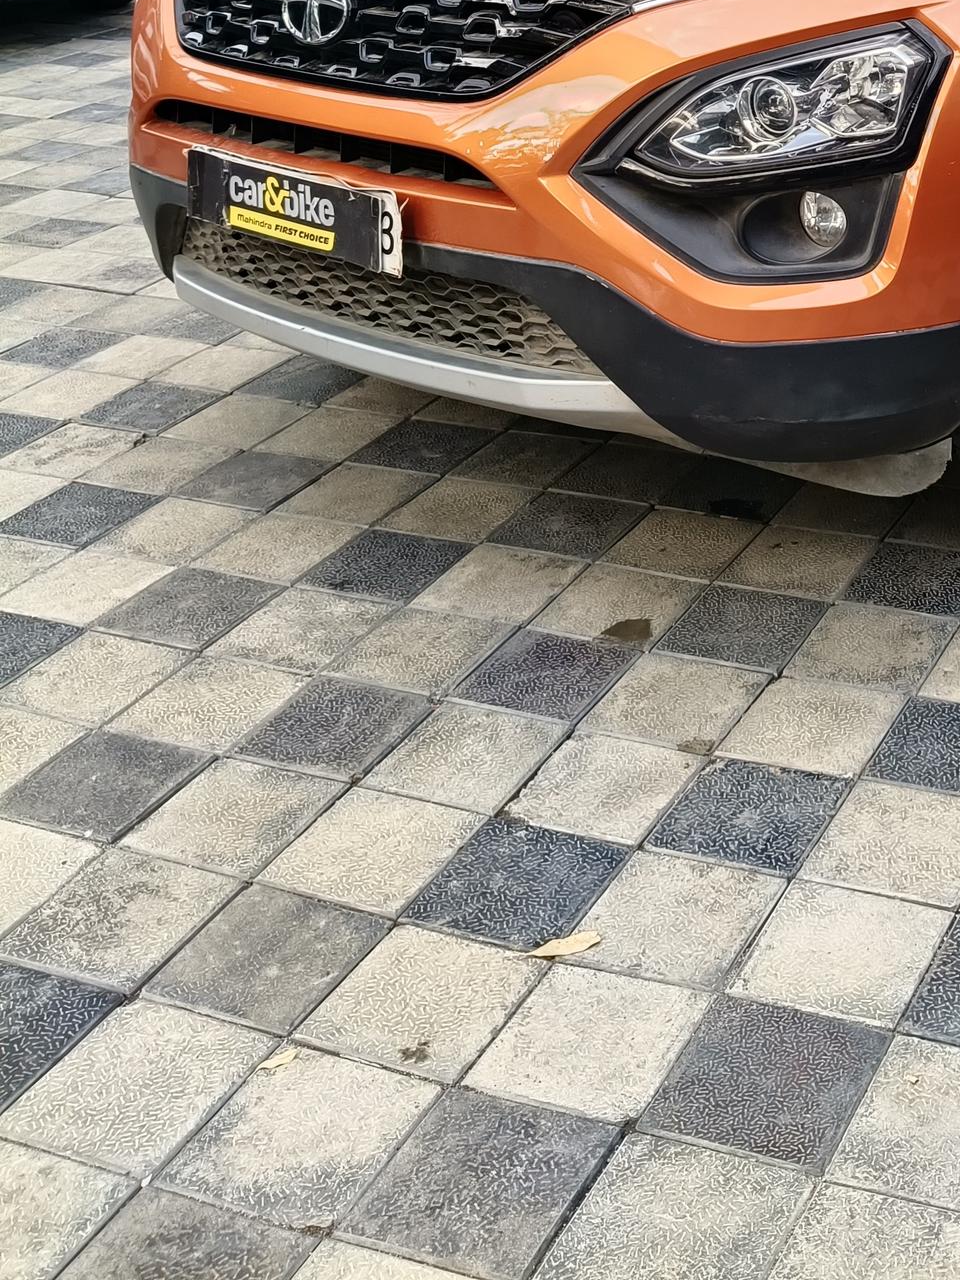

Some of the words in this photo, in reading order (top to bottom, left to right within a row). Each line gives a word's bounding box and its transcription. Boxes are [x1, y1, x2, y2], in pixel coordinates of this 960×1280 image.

[228, 175, 335, 227] car&bike
[274, 224, 298, 236] FIRST
[298, 231, 330, 245] CHOICE
